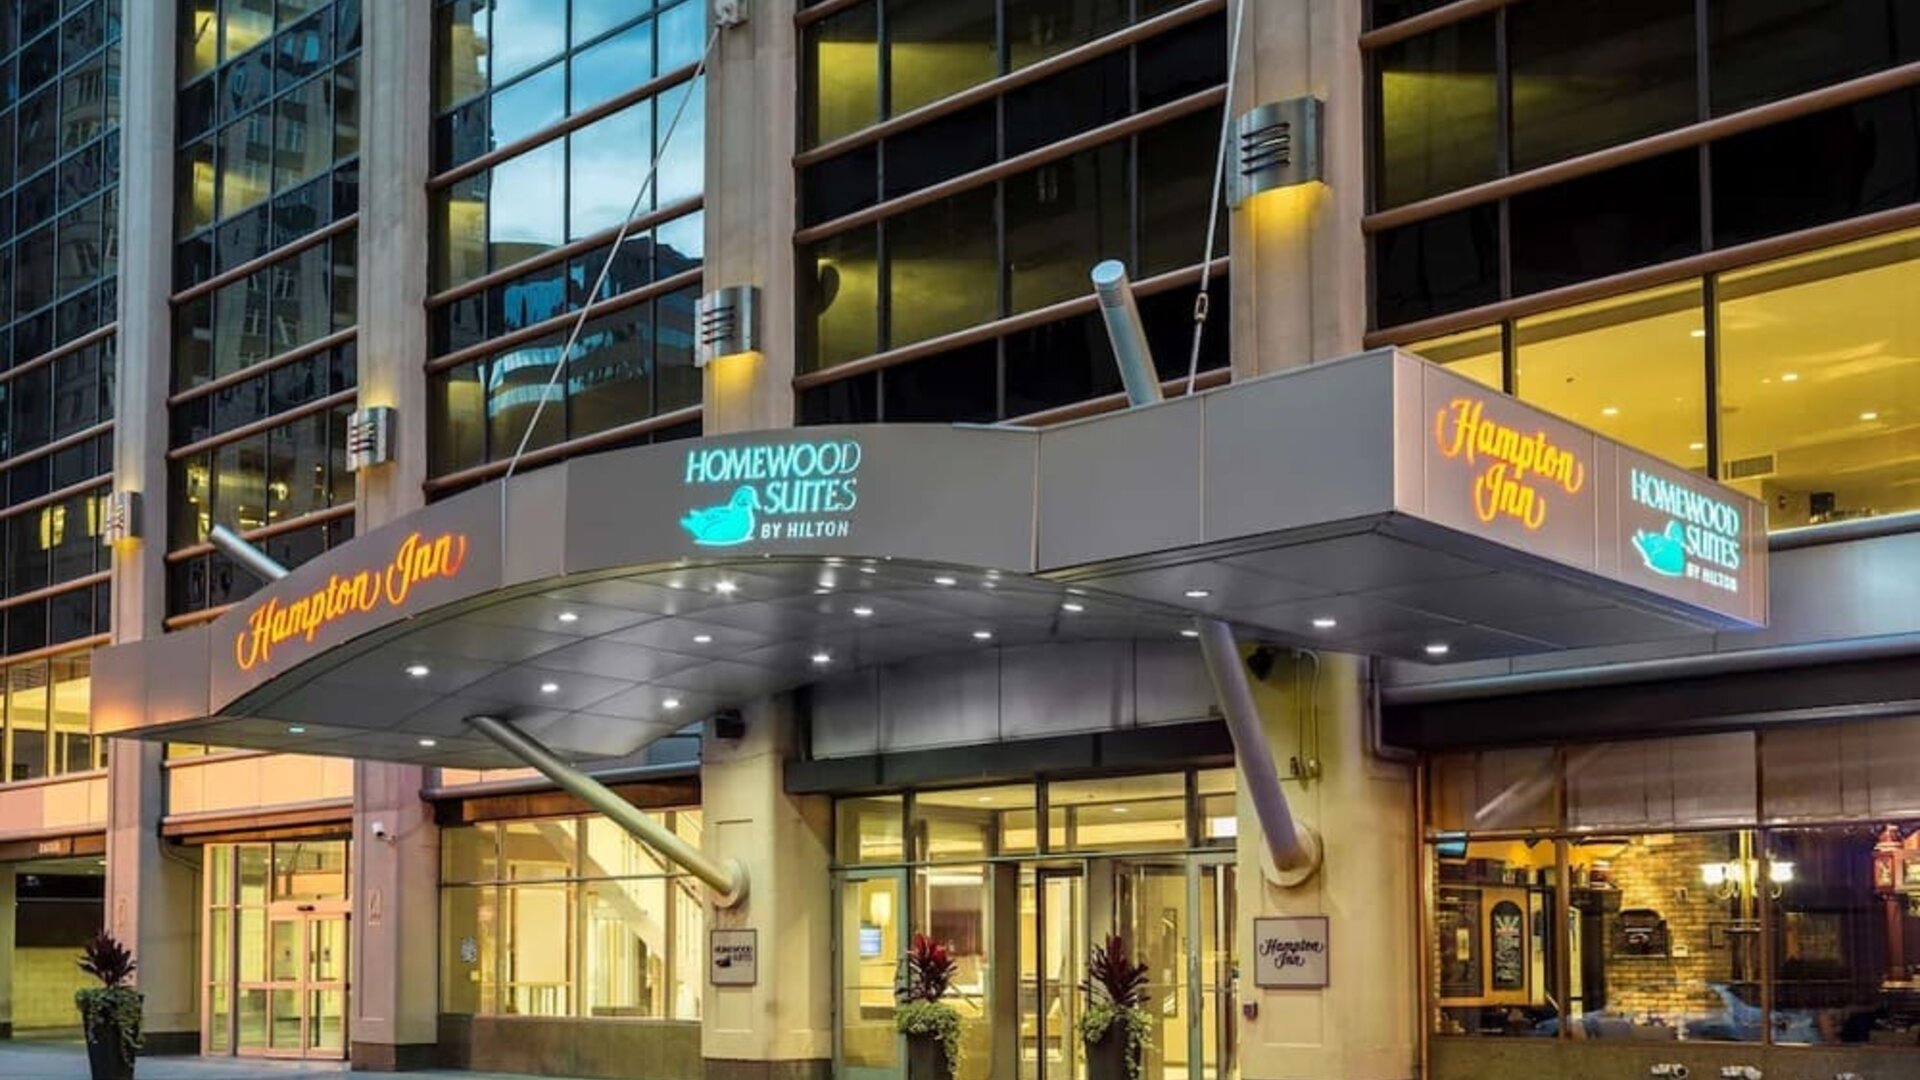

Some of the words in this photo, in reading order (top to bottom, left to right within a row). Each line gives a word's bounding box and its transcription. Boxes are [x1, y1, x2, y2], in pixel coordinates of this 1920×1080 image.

[684, 440, 861, 484] HOMEWOOD
[1436, 399, 1584, 494] Hampton
[763, 477, 857, 515] SUITES
[1475, 463, 1545, 529] Inn
[1630, 468, 1740, 538] HOMEWOOD
[760, 522, 782, 540] BY
[786, 520, 850, 539] HILTON
[1685, 525, 1740, 570] SUITES
[236, 571, 381, 670] Hampton
[385, 532, 467, 606] Inn
[1259, 938, 1324, 956] Hampton
[1274, 951, 1306, 969] Inn
